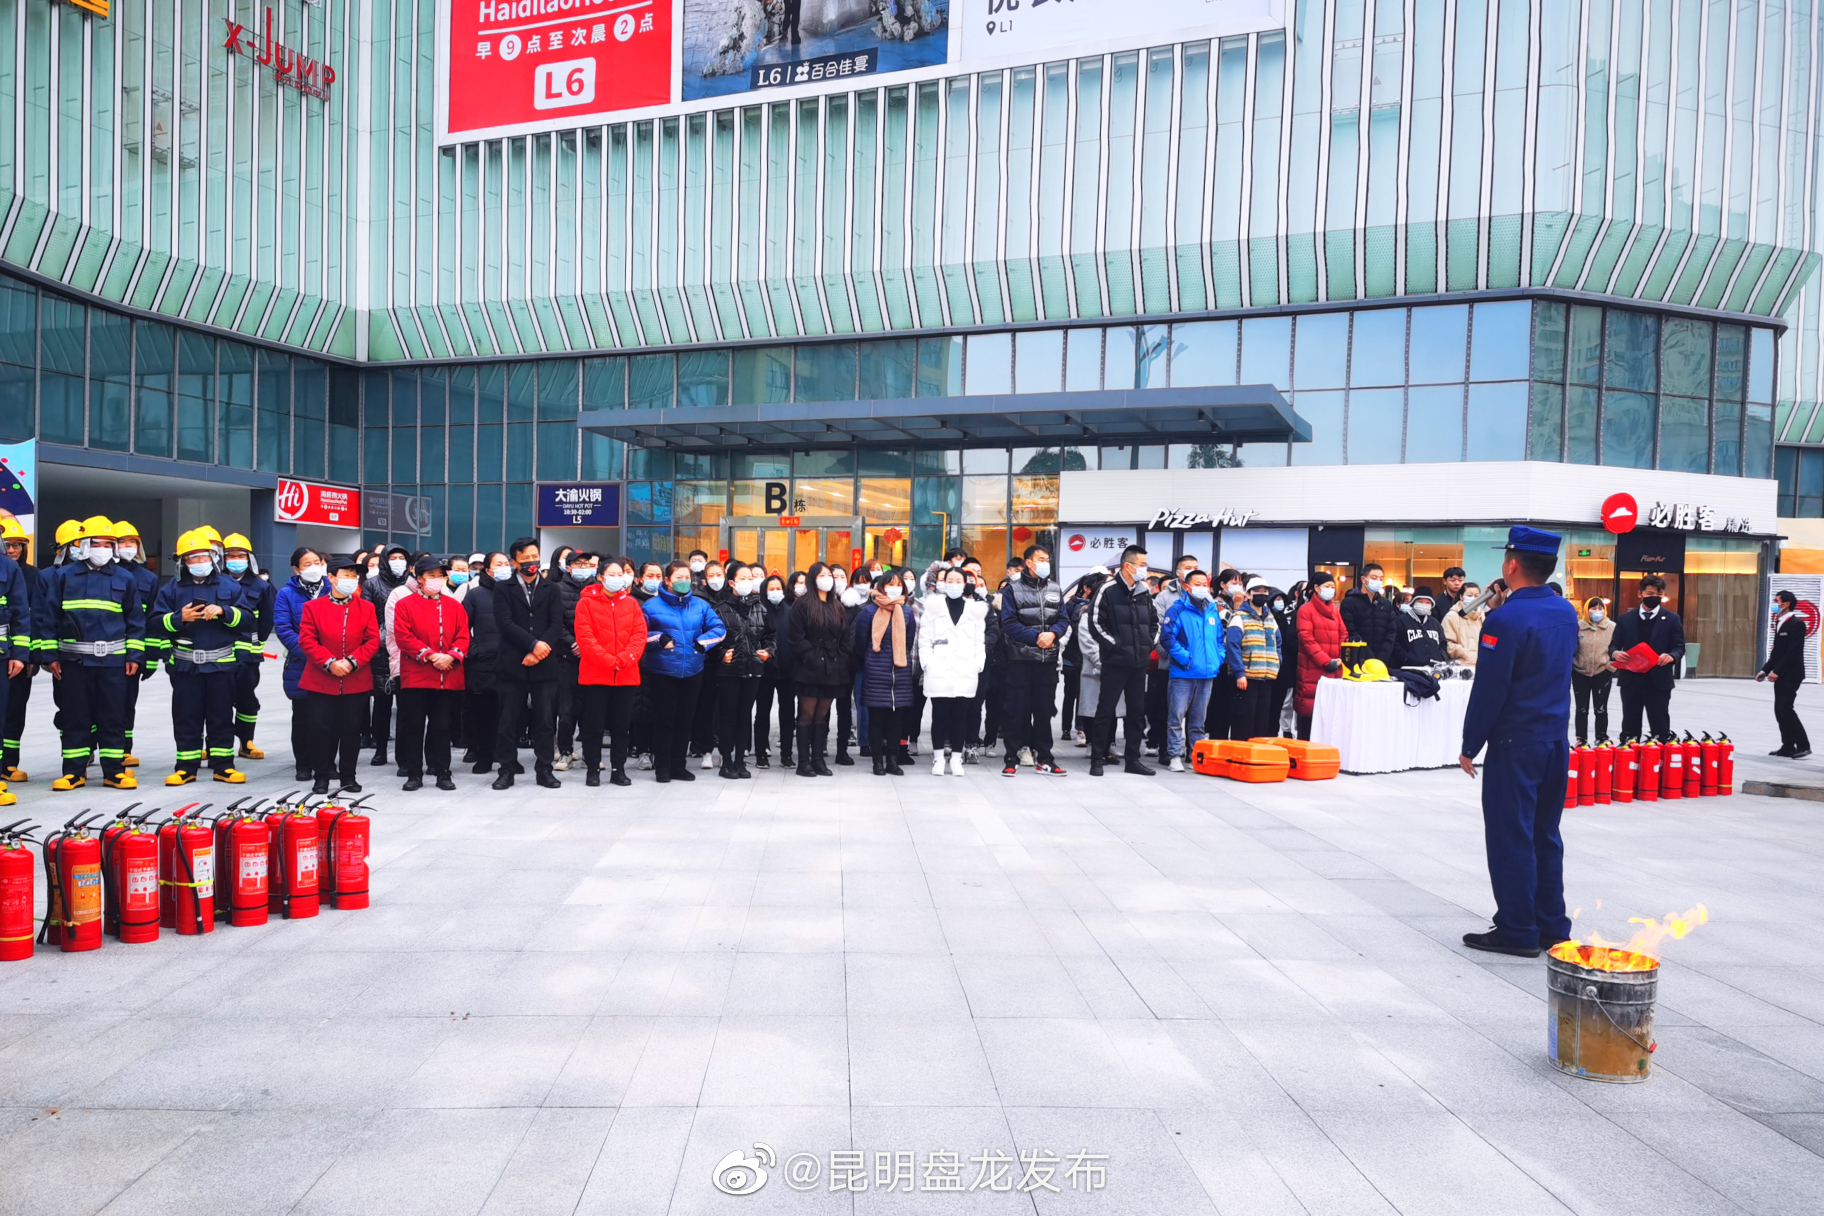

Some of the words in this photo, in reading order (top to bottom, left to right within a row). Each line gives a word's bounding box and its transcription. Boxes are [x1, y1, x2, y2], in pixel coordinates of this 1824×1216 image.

[1000, 20, 1012, 32] L1
[757, 68, 781, 86] L6
[811, 54, 869, 80] 百合佳宴
[545, 67, 585, 100] L6
[555, 488, 602, 502] 大渝火锅
[572, 516, 582, 524] L5
[1148, 507, 1210, 530] Pizza
[1210, 506, 1260, 528] Hut
[1649, 501, 1717, 531] 必胜客
[1090, 537, 1129, 549] 必胜客
